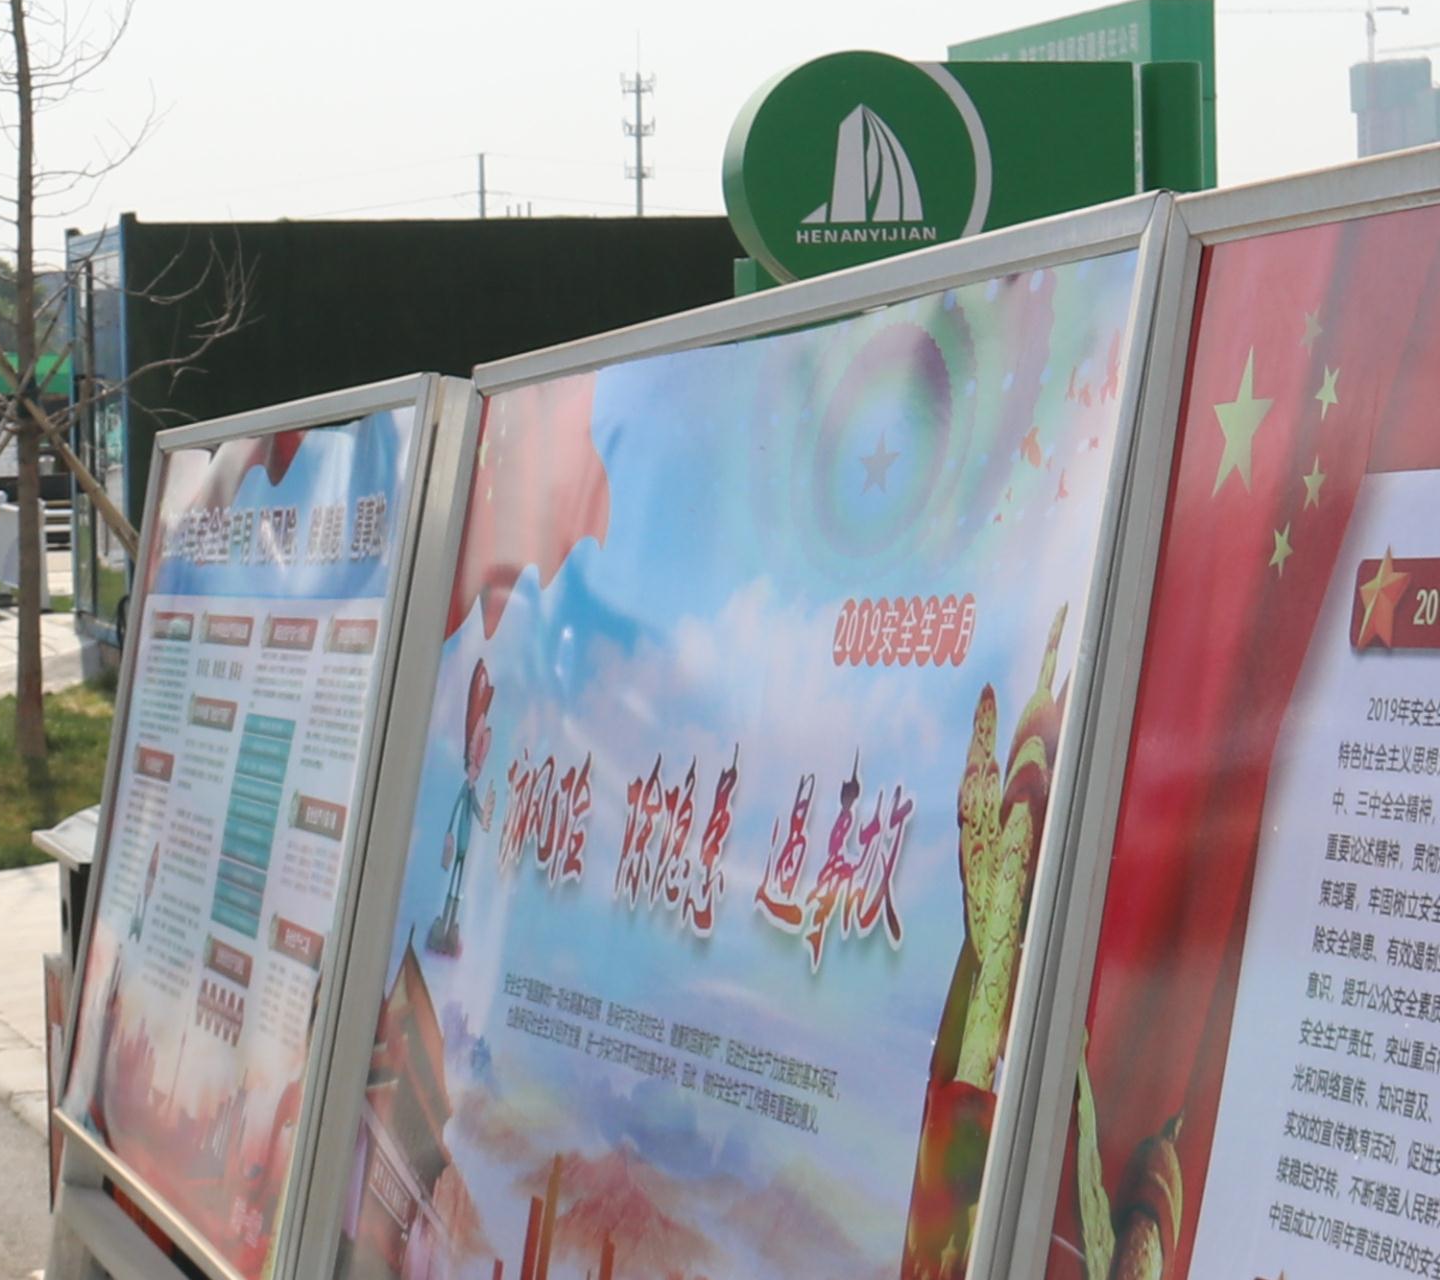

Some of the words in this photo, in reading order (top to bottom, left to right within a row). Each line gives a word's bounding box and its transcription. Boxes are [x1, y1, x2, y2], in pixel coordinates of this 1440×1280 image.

[795, 226, 938, 245] HENANYIJIAN
[833, 601, 978, 656] 2019安全生产月
